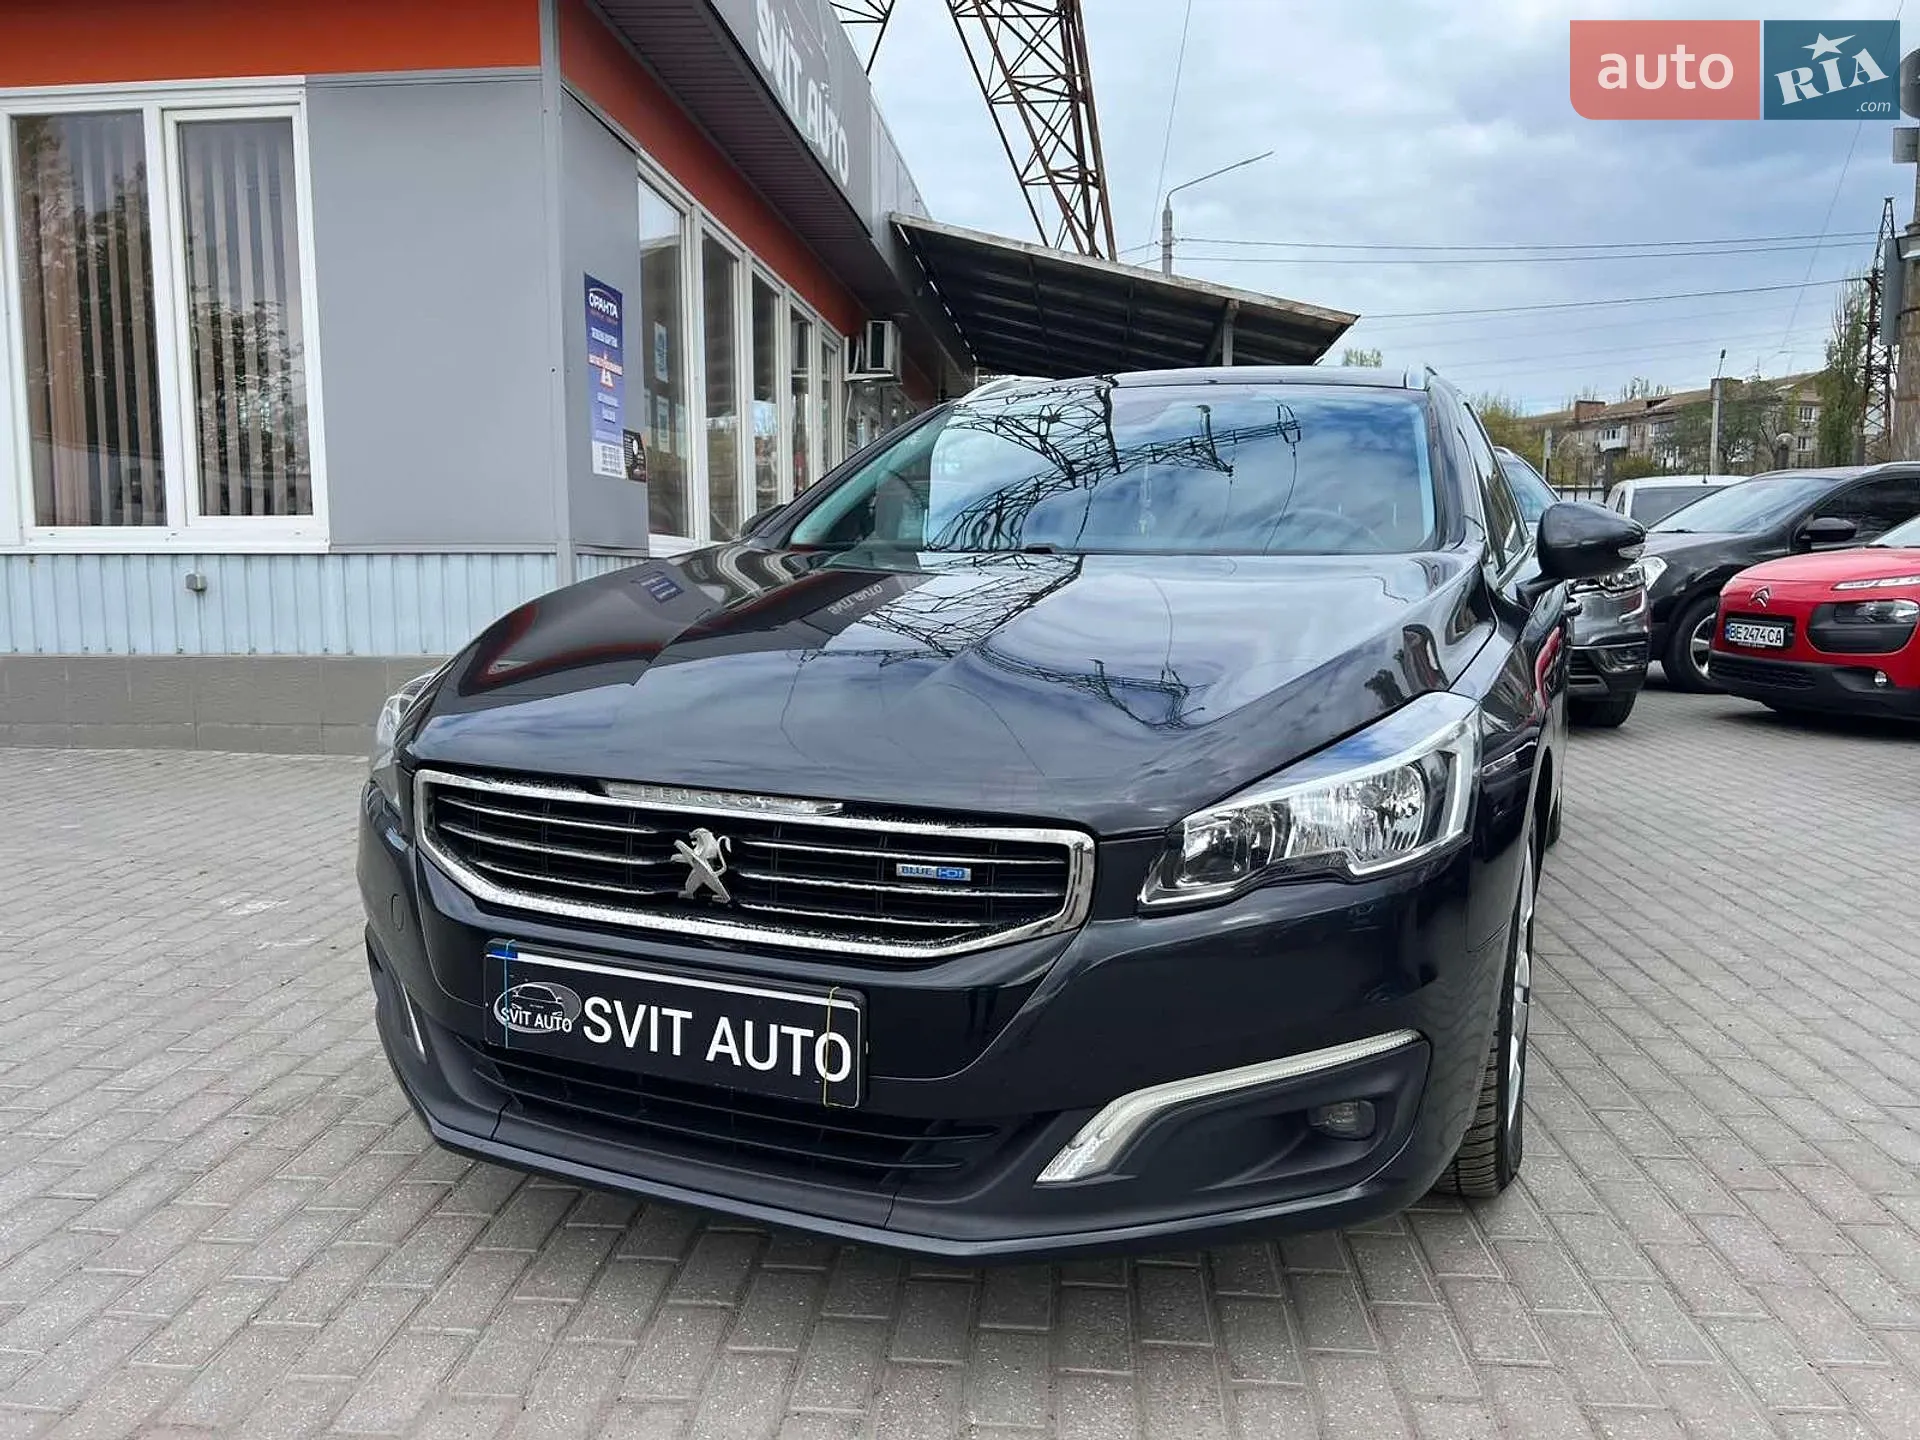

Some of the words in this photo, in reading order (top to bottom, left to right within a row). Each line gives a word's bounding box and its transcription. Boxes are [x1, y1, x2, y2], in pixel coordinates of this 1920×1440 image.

[757, 0, 802, 118] SVIT
[807, 77, 849, 186] AUTO
[500, 1006, 532, 1028] SVIT
[533, 1012, 573, 1034] AUTO
[583, 996, 693, 1056] SVIT
[705, 1016, 852, 1083] AUTO
